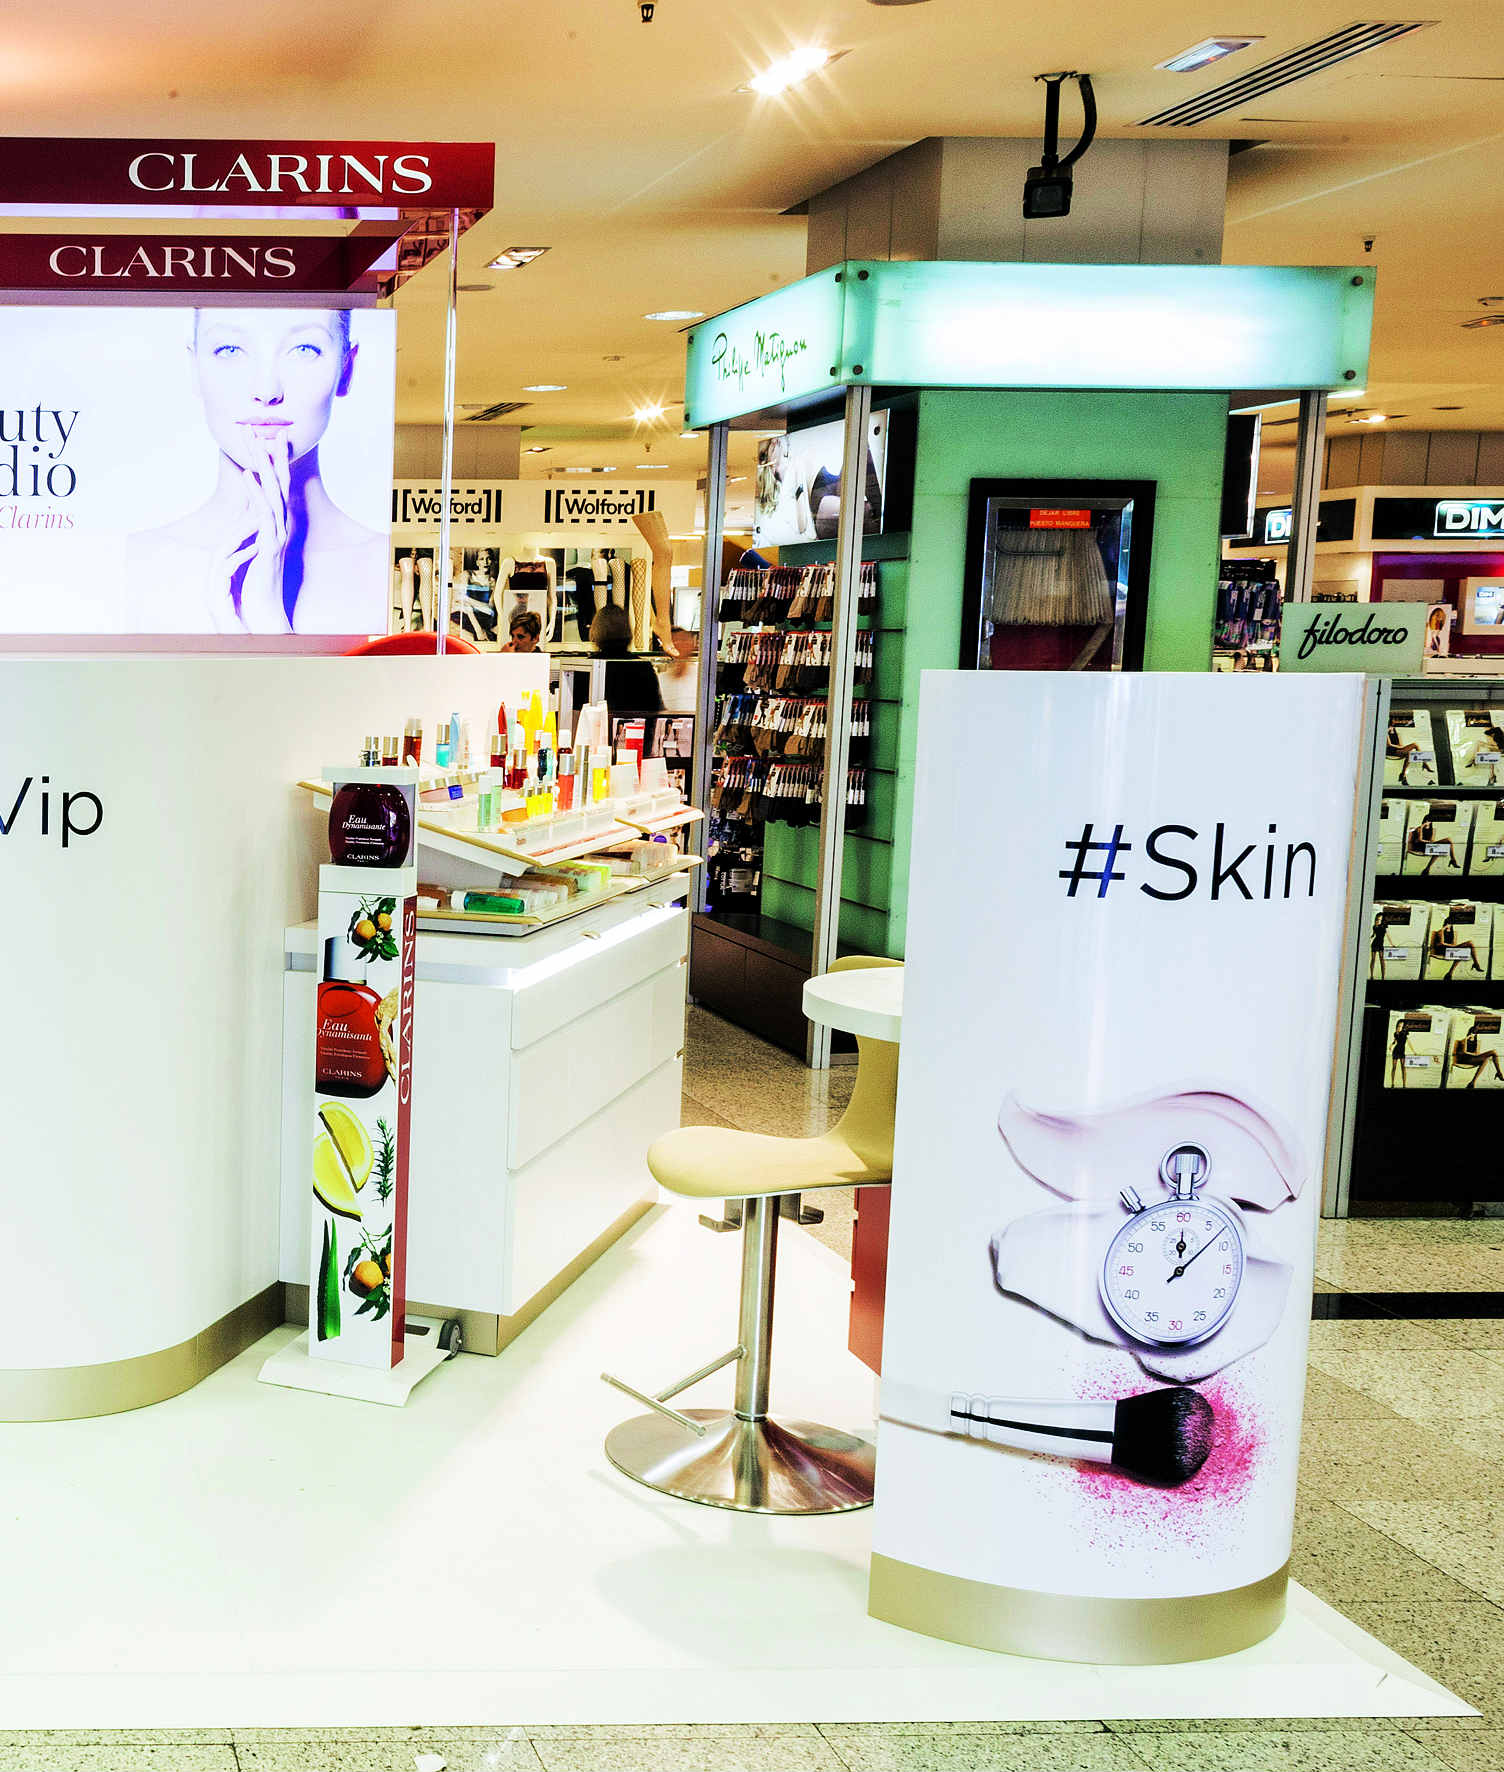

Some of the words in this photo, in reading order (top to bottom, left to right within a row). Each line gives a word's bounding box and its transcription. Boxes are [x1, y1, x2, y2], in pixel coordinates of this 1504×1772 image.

[127, 152, 433, 195] CLARINS
[49, 246, 296, 278] CLARINS
[411, 497, 483, 515] Woford
[564, 498, 636, 516] Wolford
[1445, 507, 1504, 530] DIM
[1270, 514, 1292, 538] DI
[1298, 613, 1408, 660] filodoro
[348, 814, 368, 825] Eau
[342, 821, 387, 831] Dynamisante
[1058, 822, 1316, 901] #Skin
[400, 910, 415, 1105] CLARINS
[323, 1018, 349, 1032] Eau
[322, 1067, 363, 1078] CLARINS
[1176, 1212, 1191, 1222] 60
[1151, 1222, 1166, 1232] 55
[1206, 1221, 1213, 1231] 5
[1128, 1243, 1144, 1253] 50
[1119, 1265, 1134, 1276] 45
[1222, 1264, 1232, 1274] 15
[1124, 1290, 1139, 1300] 40
[1213, 1288, 1225, 1298] 20
[1144, 1312, 1159, 1322] 35
[1193, 1311, 1206, 1321] 25
[1168, 1321, 1183, 1331] 30
